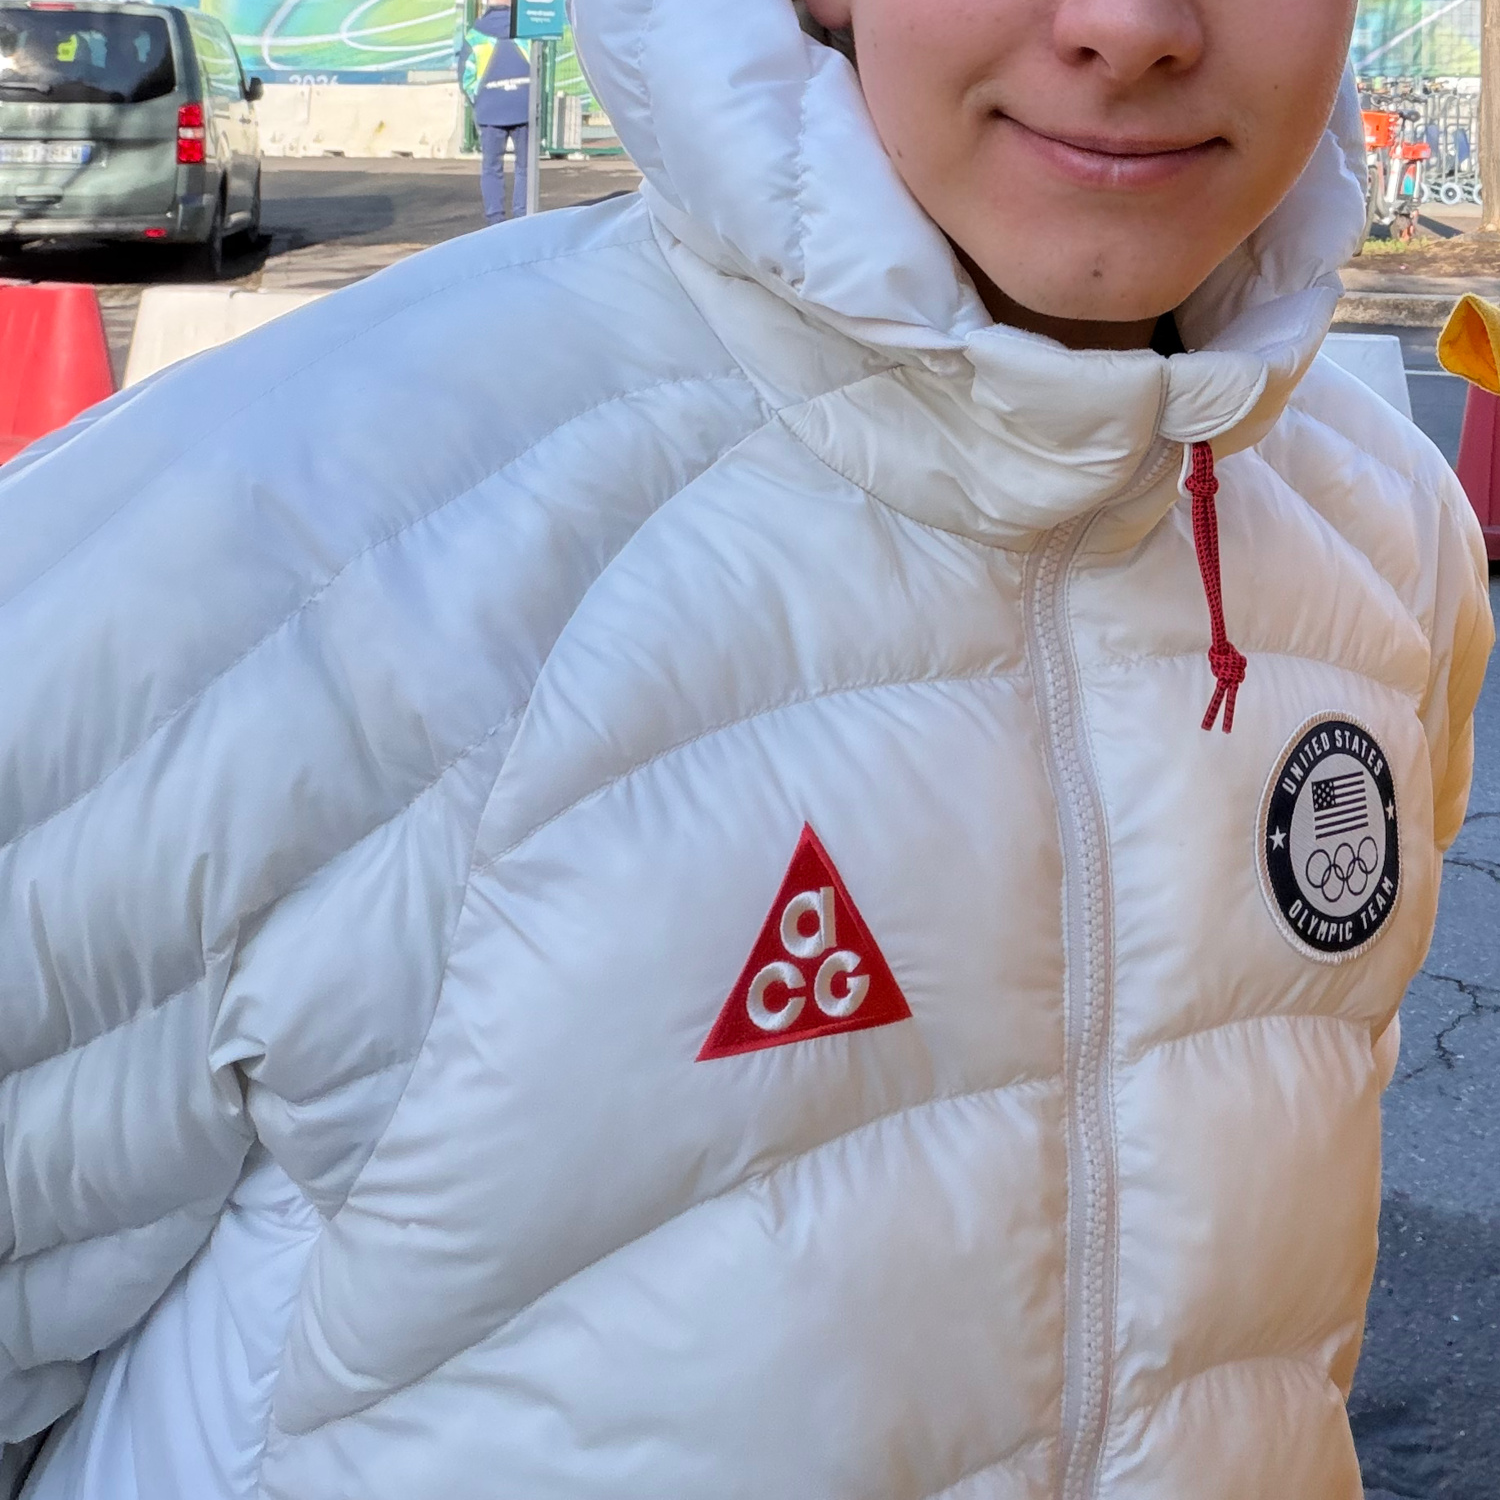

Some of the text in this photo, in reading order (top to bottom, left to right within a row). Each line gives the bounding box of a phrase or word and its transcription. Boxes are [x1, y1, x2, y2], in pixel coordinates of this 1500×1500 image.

[1282, 729, 1384, 795] UNITED STATES
[1288, 876, 1394, 943] OLYMPIC TEAM
